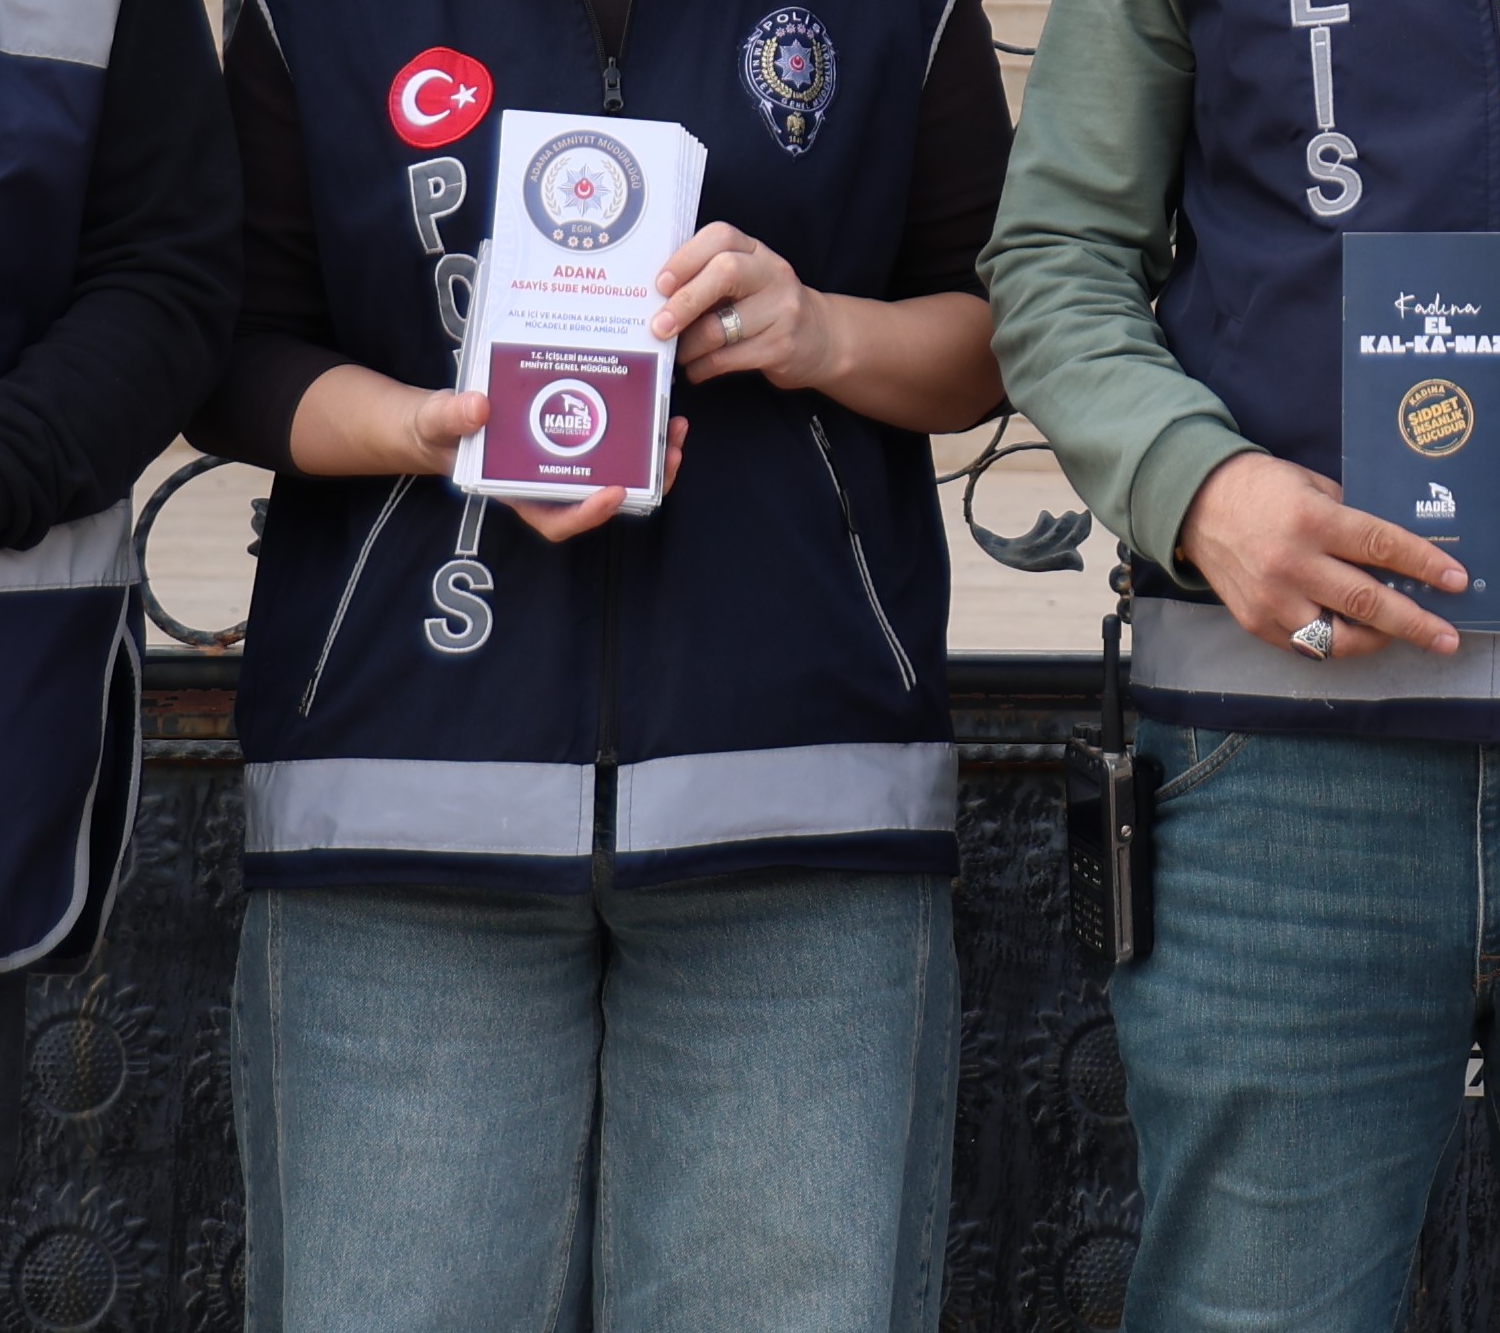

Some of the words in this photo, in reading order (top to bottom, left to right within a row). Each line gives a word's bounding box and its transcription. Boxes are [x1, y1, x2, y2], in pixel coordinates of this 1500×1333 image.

[762, 11, 821, 33] POLİS
[530, 149, 553, 182] ADANA
[553, 135, 596, 152] EMNİYET
[597, 137, 642, 189] MÜDÜRLÜĞÜ
[571, 224, 592, 233] EGM
[553, 265, 607, 280] ADANA
[511, 279, 549, 292] ASAYİŞ
[551, 283, 578, 294] ŞUBE
[581, 284, 648, 298] MÜDÜRLÜĞÜ
[508, 309, 526, 318] AİLE
[540, 312, 550, 320] VE
[551, 312, 582, 321] KADINA
[584, 315, 607, 324] KARŞI
[525, 320, 567, 331] MÜCADELE
[569, 323, 592, 332] BÜRO
[1424, 316, 1452, 334] EL
[530, 351, 545, 360] T.C.
[520, 360, 553, 369] EMNİYET
[555, 363, 579, 371] GENEL
[581, 364, 628, 374] MÜDÜRLÜĞÜ
[1408, 385, 1446, 406] KADINA
[408, 156, 494, 655] POİS
[544, 413, 592, 429] KADES
[538, 464, 571, 475] YARDIM
[573, 465, 592, 476] İSTE
[1416, 500, 1456, 513] KADES
